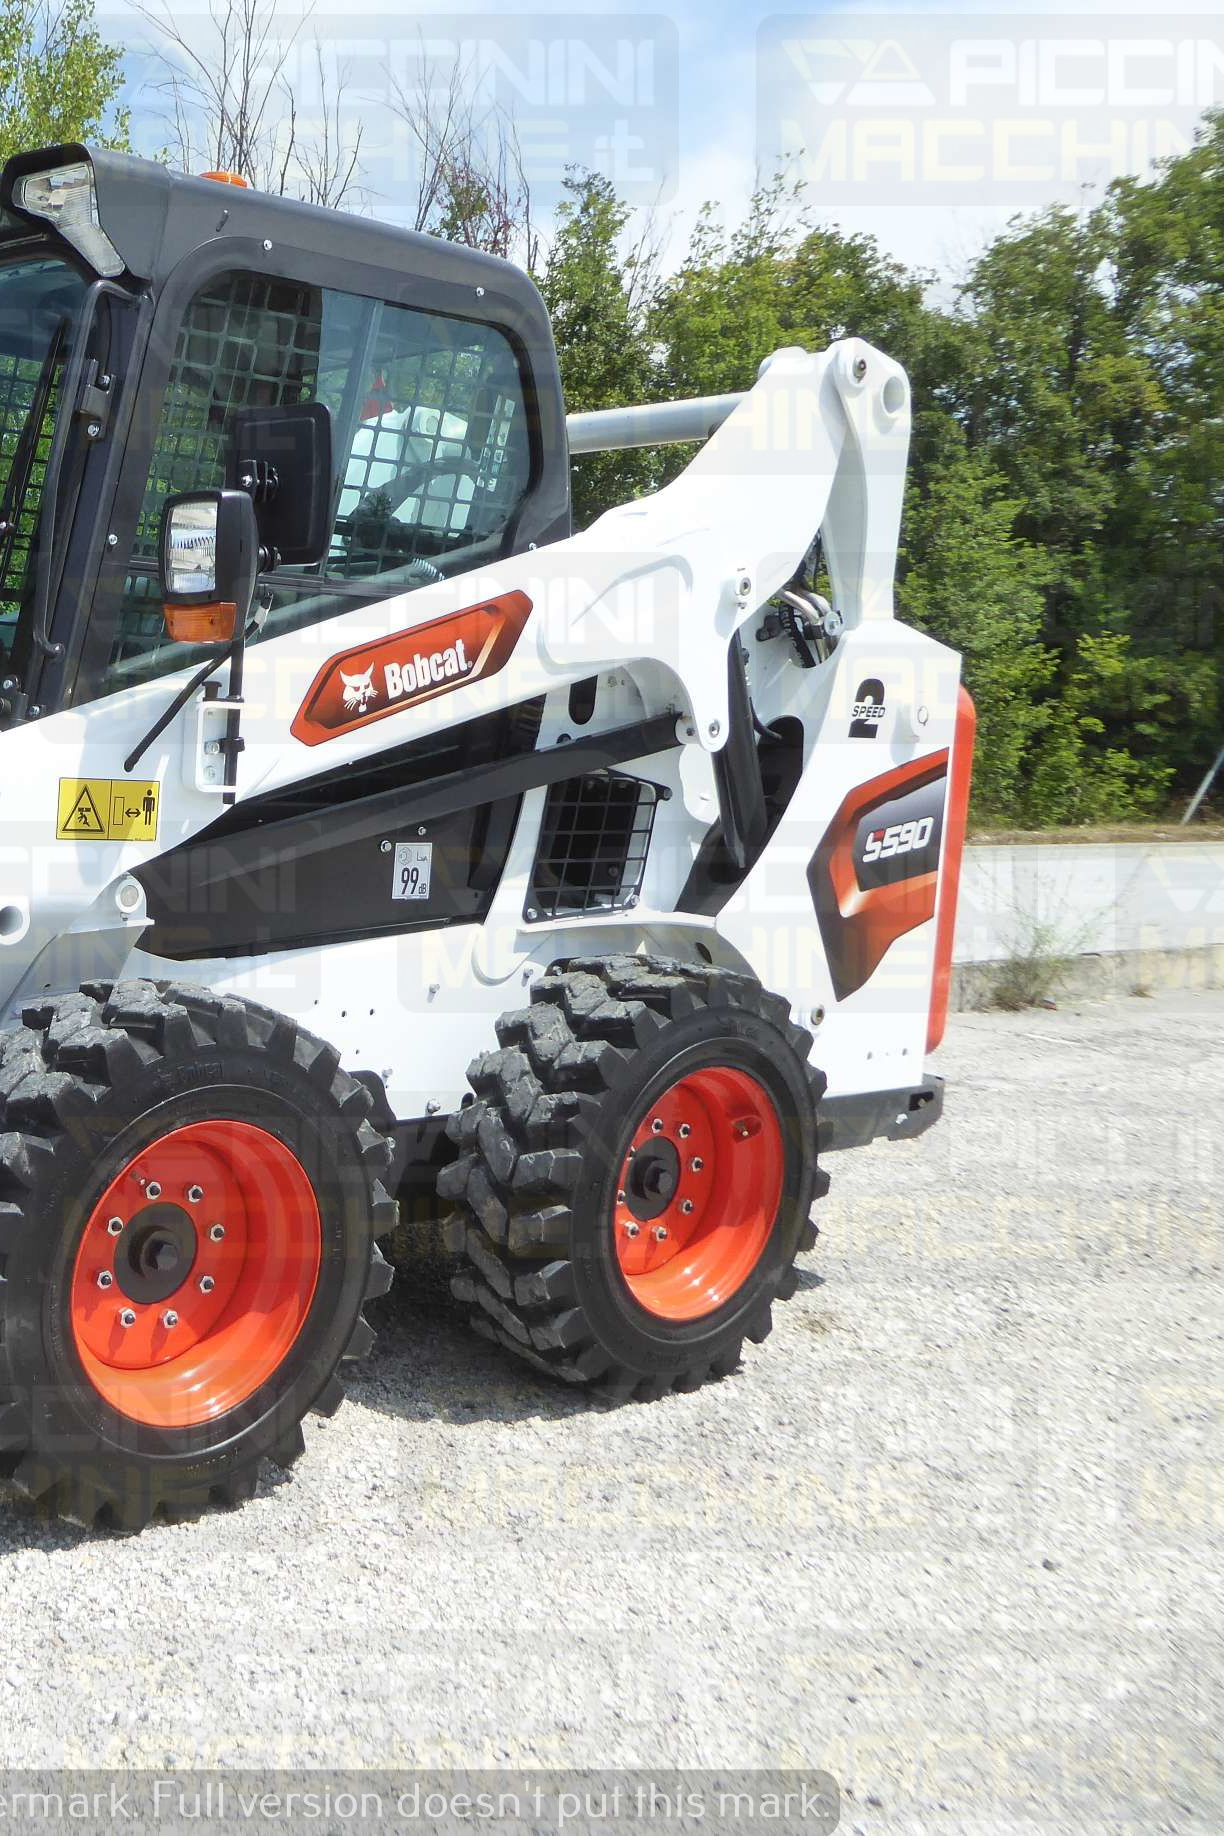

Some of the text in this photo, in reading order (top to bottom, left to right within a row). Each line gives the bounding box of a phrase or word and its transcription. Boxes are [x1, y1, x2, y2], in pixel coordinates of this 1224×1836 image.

[384, 638, 468, 700] Bobcat
[852, 705, 886, 718] SPEED
[862, 816, 935, 863] S590
[401, 867, 420, 895] 99
